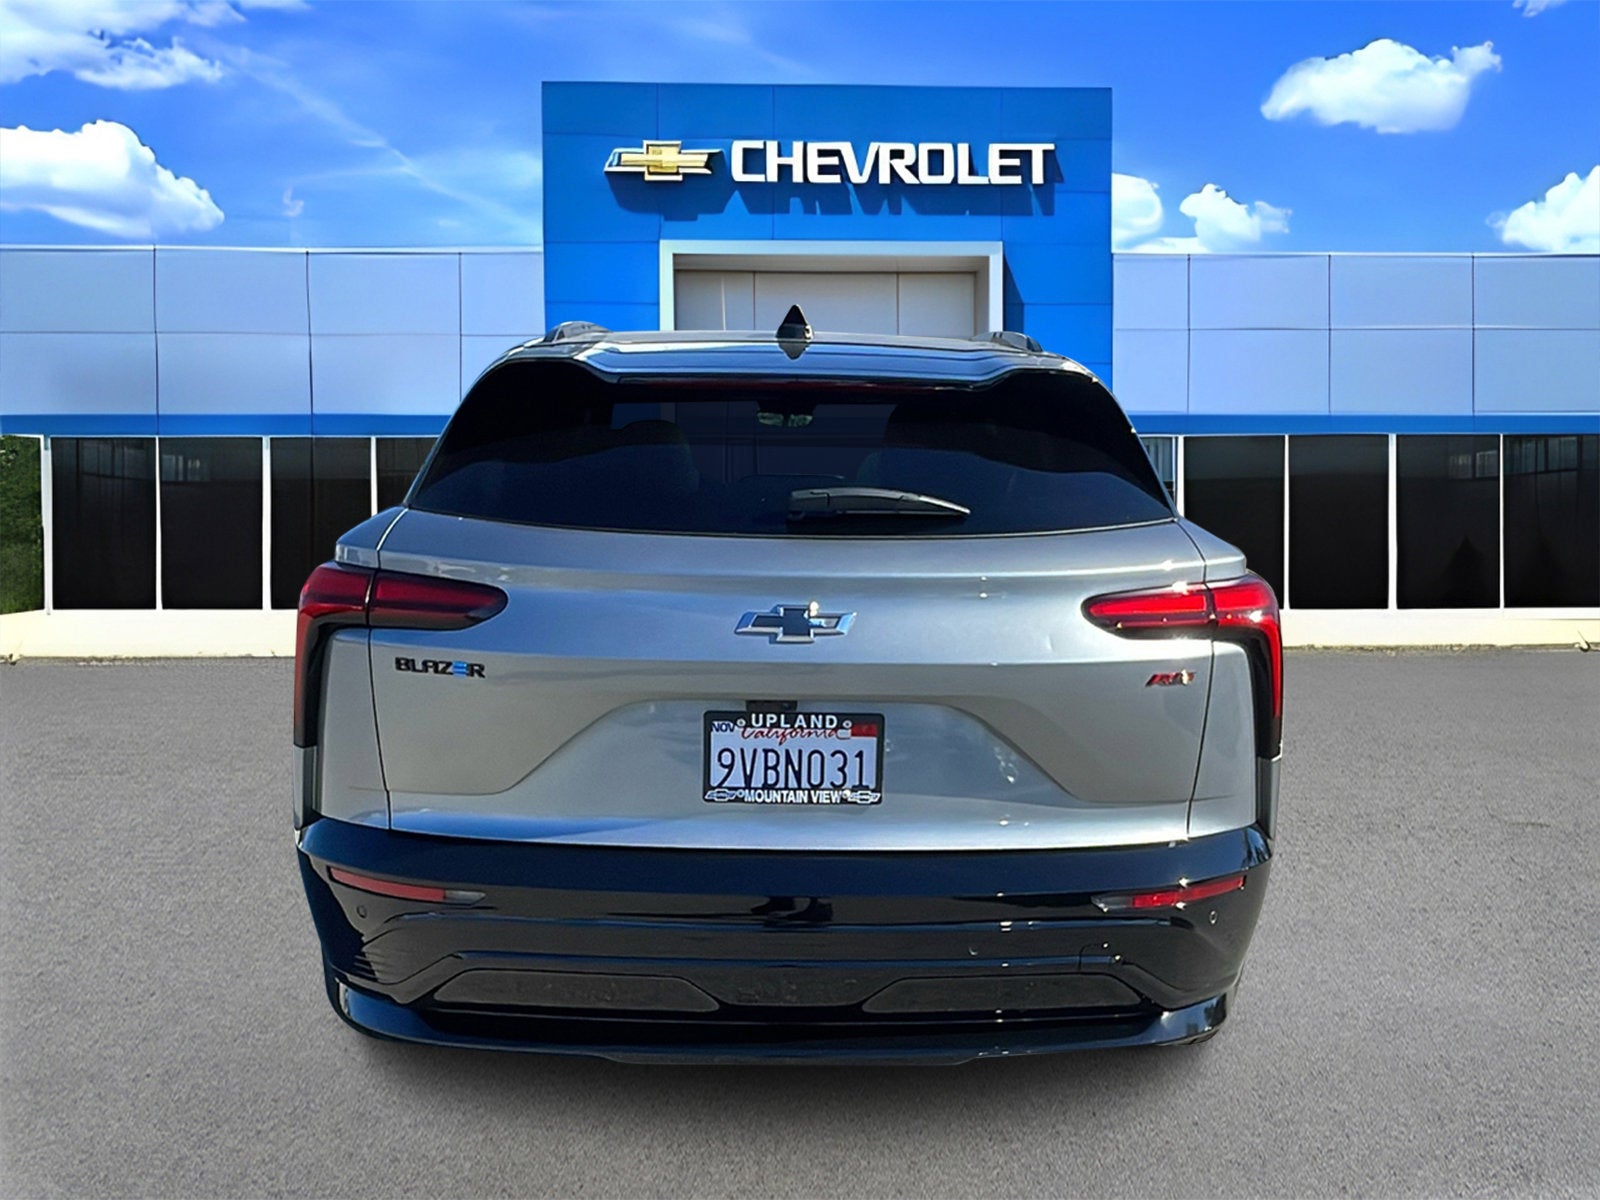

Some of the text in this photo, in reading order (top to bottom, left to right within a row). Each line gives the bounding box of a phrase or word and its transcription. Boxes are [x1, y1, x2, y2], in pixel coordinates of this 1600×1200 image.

[731, 140, 1055, 185] CHEVROLET
[395, 657, 485, 678] BLAZER
[711, 721, 736, 733] NOV
[751, 713, 838, 728] UPLAND
[717, 747, 869, 788] 9VBN031
[744, 789, 808, 803] MOUNTAIN
[811, 790, 842, 804] VIEW
